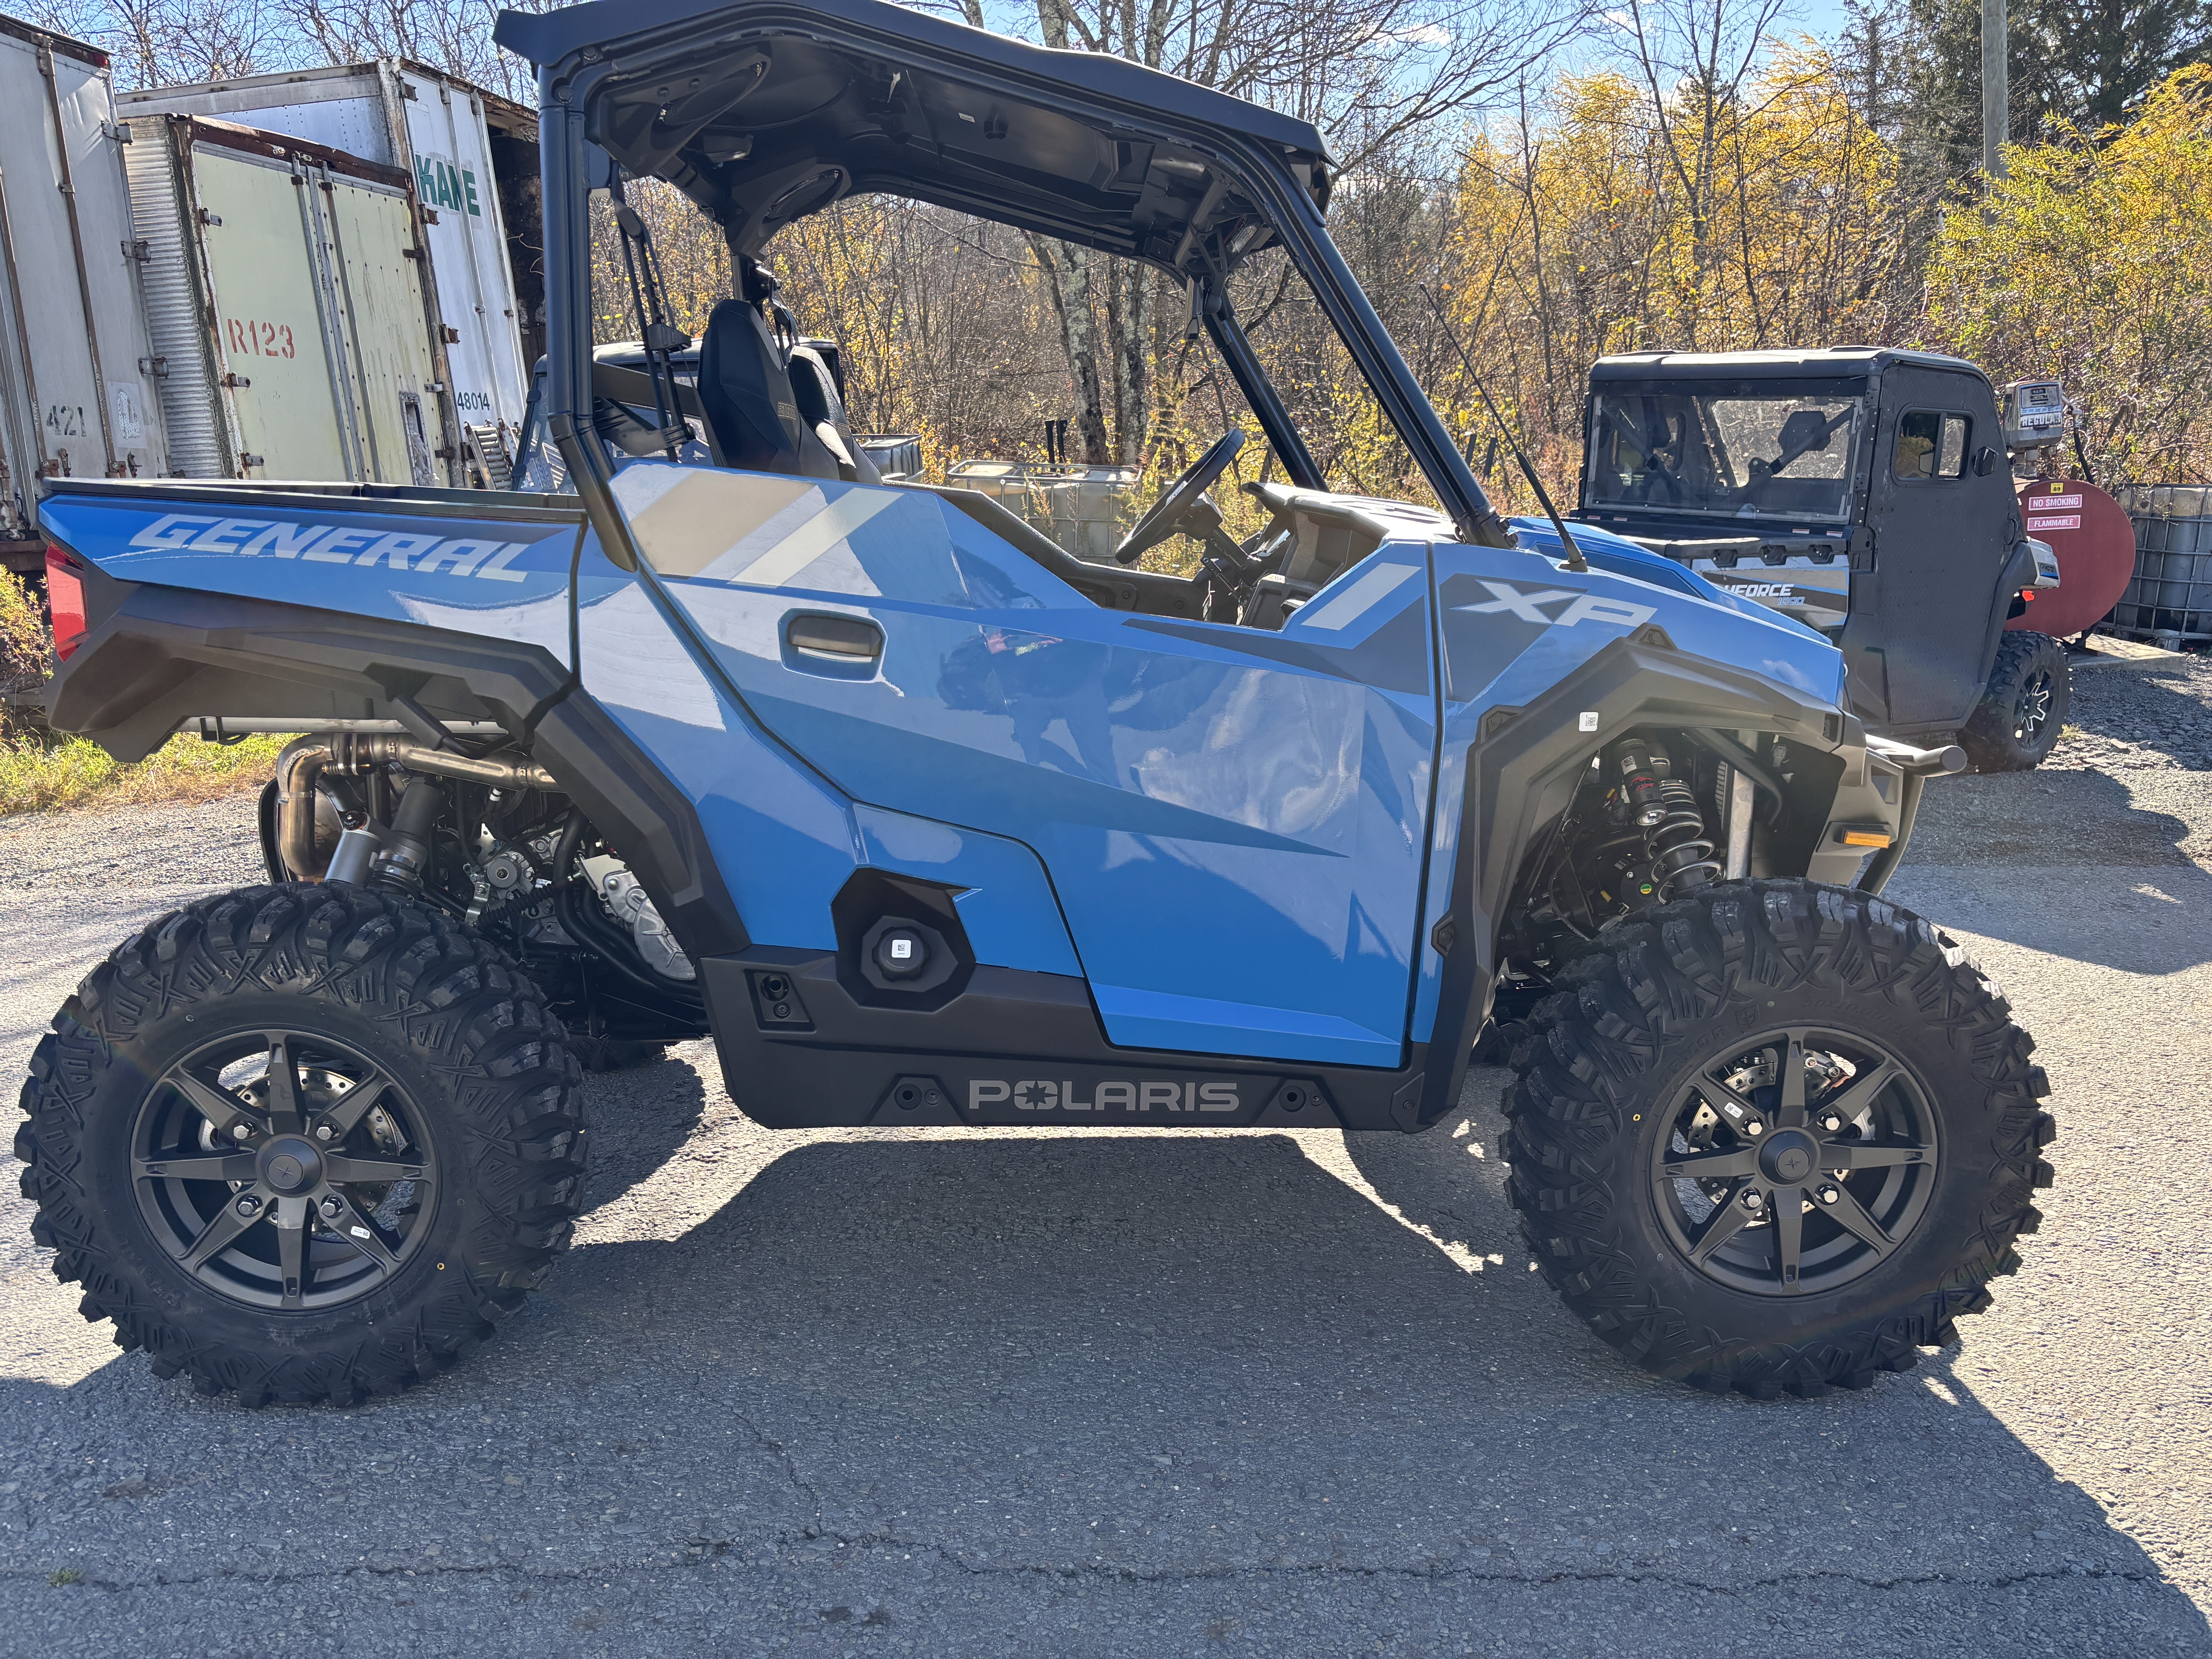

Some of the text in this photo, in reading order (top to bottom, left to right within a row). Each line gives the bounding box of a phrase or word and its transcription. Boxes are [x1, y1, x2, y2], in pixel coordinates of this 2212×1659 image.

[416, 155, 480, 216] KANE
[227, 319, 295, 359] R123
[457, 392, 490, 410] 48014
[46, 405, 87, 437] 421
[2022, 414, 2060, 426] REGULAR
[2033, 497, 2079, 507] NO SMOKING
[2034, 519, 2074, 527] FLAMMABLE
[129, 513, 528, 582] GENERAL
[1449, 579, 1658, 627] XP
[1778, 597, 1805, 605] 1000
[969, 1079, 1240, 1111] POLARIS
